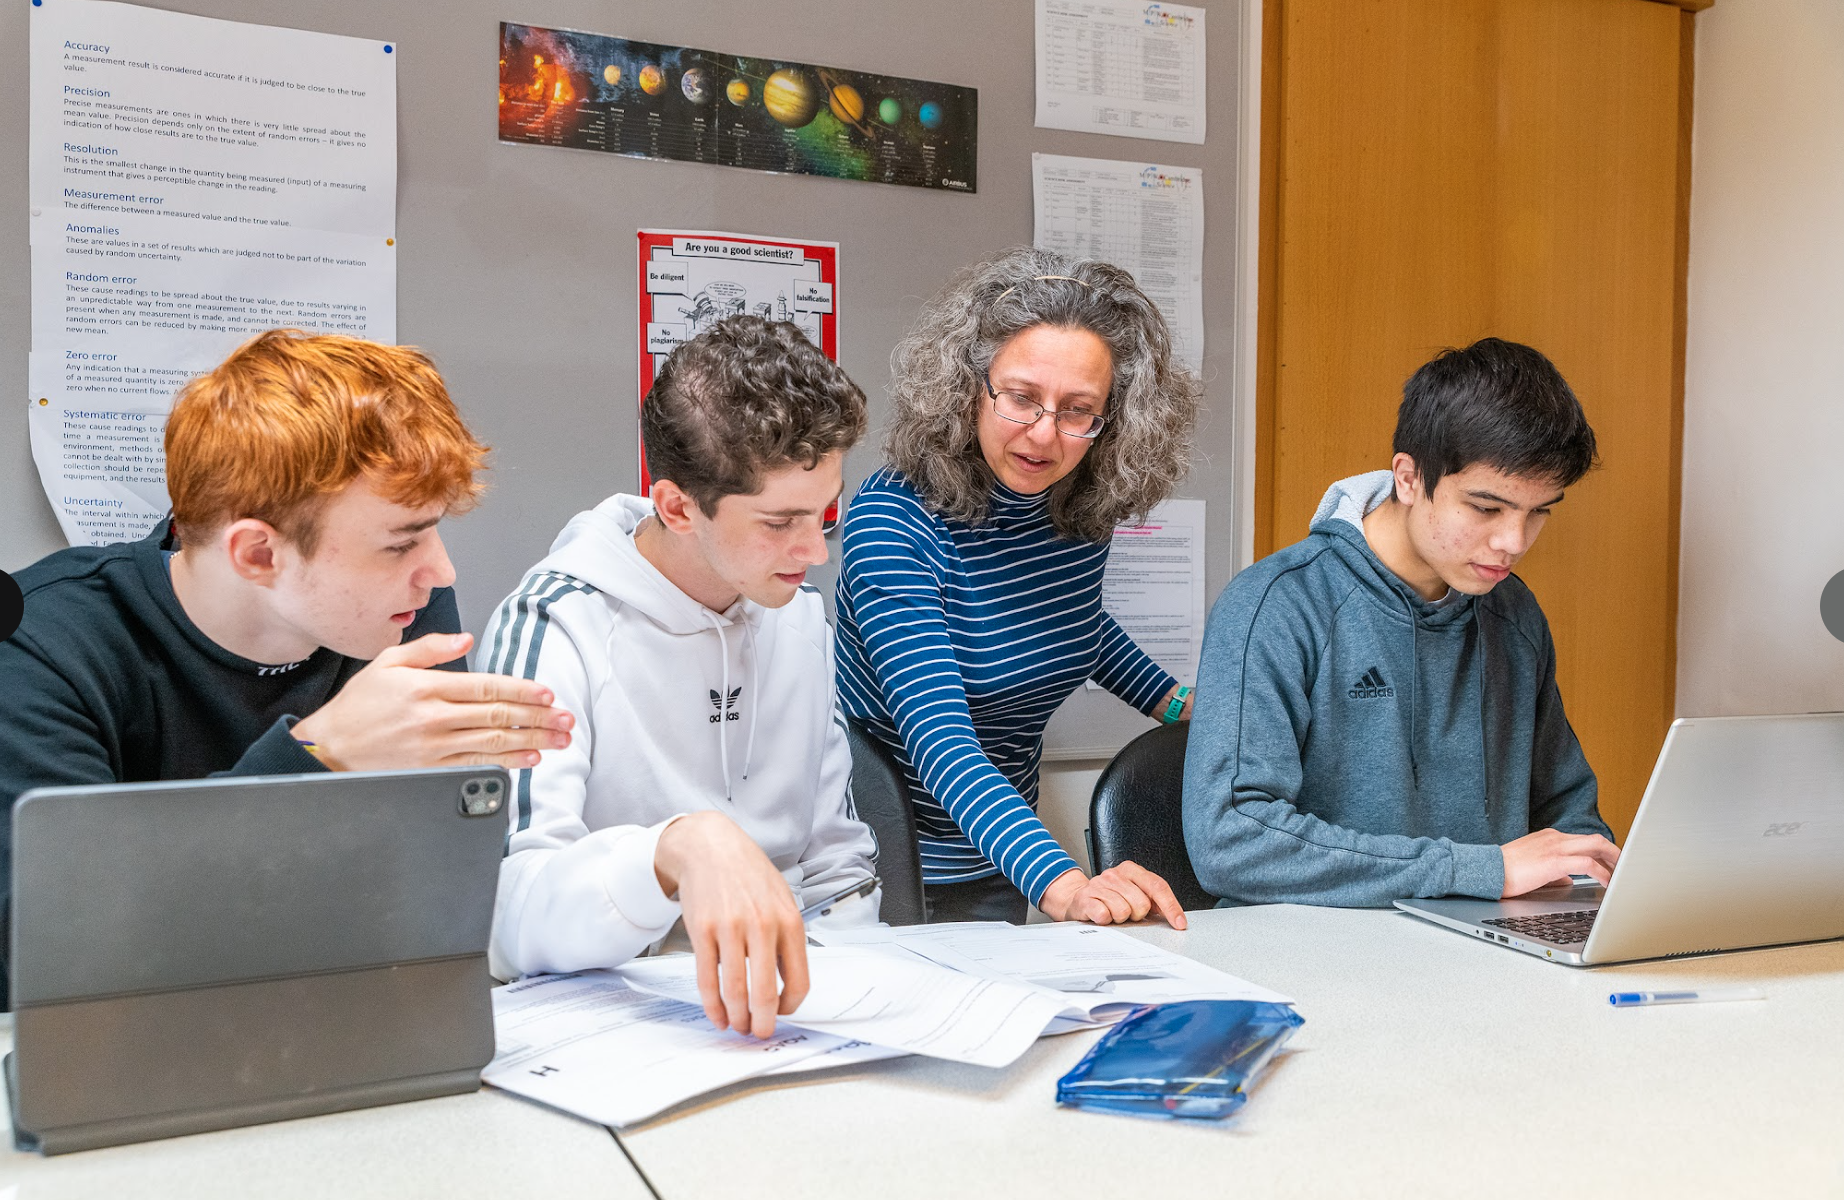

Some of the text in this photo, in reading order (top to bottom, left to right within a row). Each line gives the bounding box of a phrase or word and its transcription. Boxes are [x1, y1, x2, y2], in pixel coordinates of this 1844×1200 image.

[64, 41, 109, 54] Accuracy
[72, 56, 126, 66] measurement
[161, 66, 202, 75] considered
[204, 72, 236, 80] accurate
[260, 79, 285, 87] judged
[64, 86, 110, 98] Precision
[64, 99, 92, 107] Precise
[95, 103, 153, 114] measurements
[231, 118, 251, 126] there
[283, 124, 299, 132] little
[64, 119, 102, 129] indication
[115, 124, 132, 132] how
[237, 139, 259, 147] value.
[64, 143, 118, 155] Resolution
[64, 156, 80, 164] This
[91, 158, 104, 166] the
[140, 163, 167, 172] change
[194, 170, 225, 179] quantity
[227, 172, 247, 181] being
[287, 178, 311, 186] (input)
[330, 183, 366, 191] measuring
[64, 166, 106, 176] instrument
[108, 170, 124, 178] that
[126, 172, 145, 180] gives
[154, 176, 196, 185] perceptible
[198, 180, 224, 189] change
[249, 186, 278, 194] reading.
[64, 189, 164, 204] Measurement error
[64, 201, 79, 209] The
[80, 203, 120, 212] difference
[121, 206, 155, 214] between
[66, 224, 120, 235] Anomalies
[95, 249, 105, 257] by
[138, 253, 181, 262] uncertainty.
[686, 242, 701, 251] Are
[703, 246, 719, 254] you
[730, 247, 751, 255] good
[754, 248, 794, 259] scientist?
[67, 272, 137, 285] Random error
[66, 284, 89, 292] These
[116, 289, 148, 297] readings
[257, 298, 278, 306] value,
[332, 304, 358, 312] varying
[797, 295, 830, 303] falsification
[66, 350, 89, 360] Zero
[63, 409, 146, 421] Systematic error
[115, 425, 147, 433] readings
[64, 474, 108, 482] equipment,
[64, 497, 123, 509] Uncertainty
[1348, 687, 1394, 699] adidas
[710, 711, 739, 723] adas
[1762, 821, 1810, 836] acer
